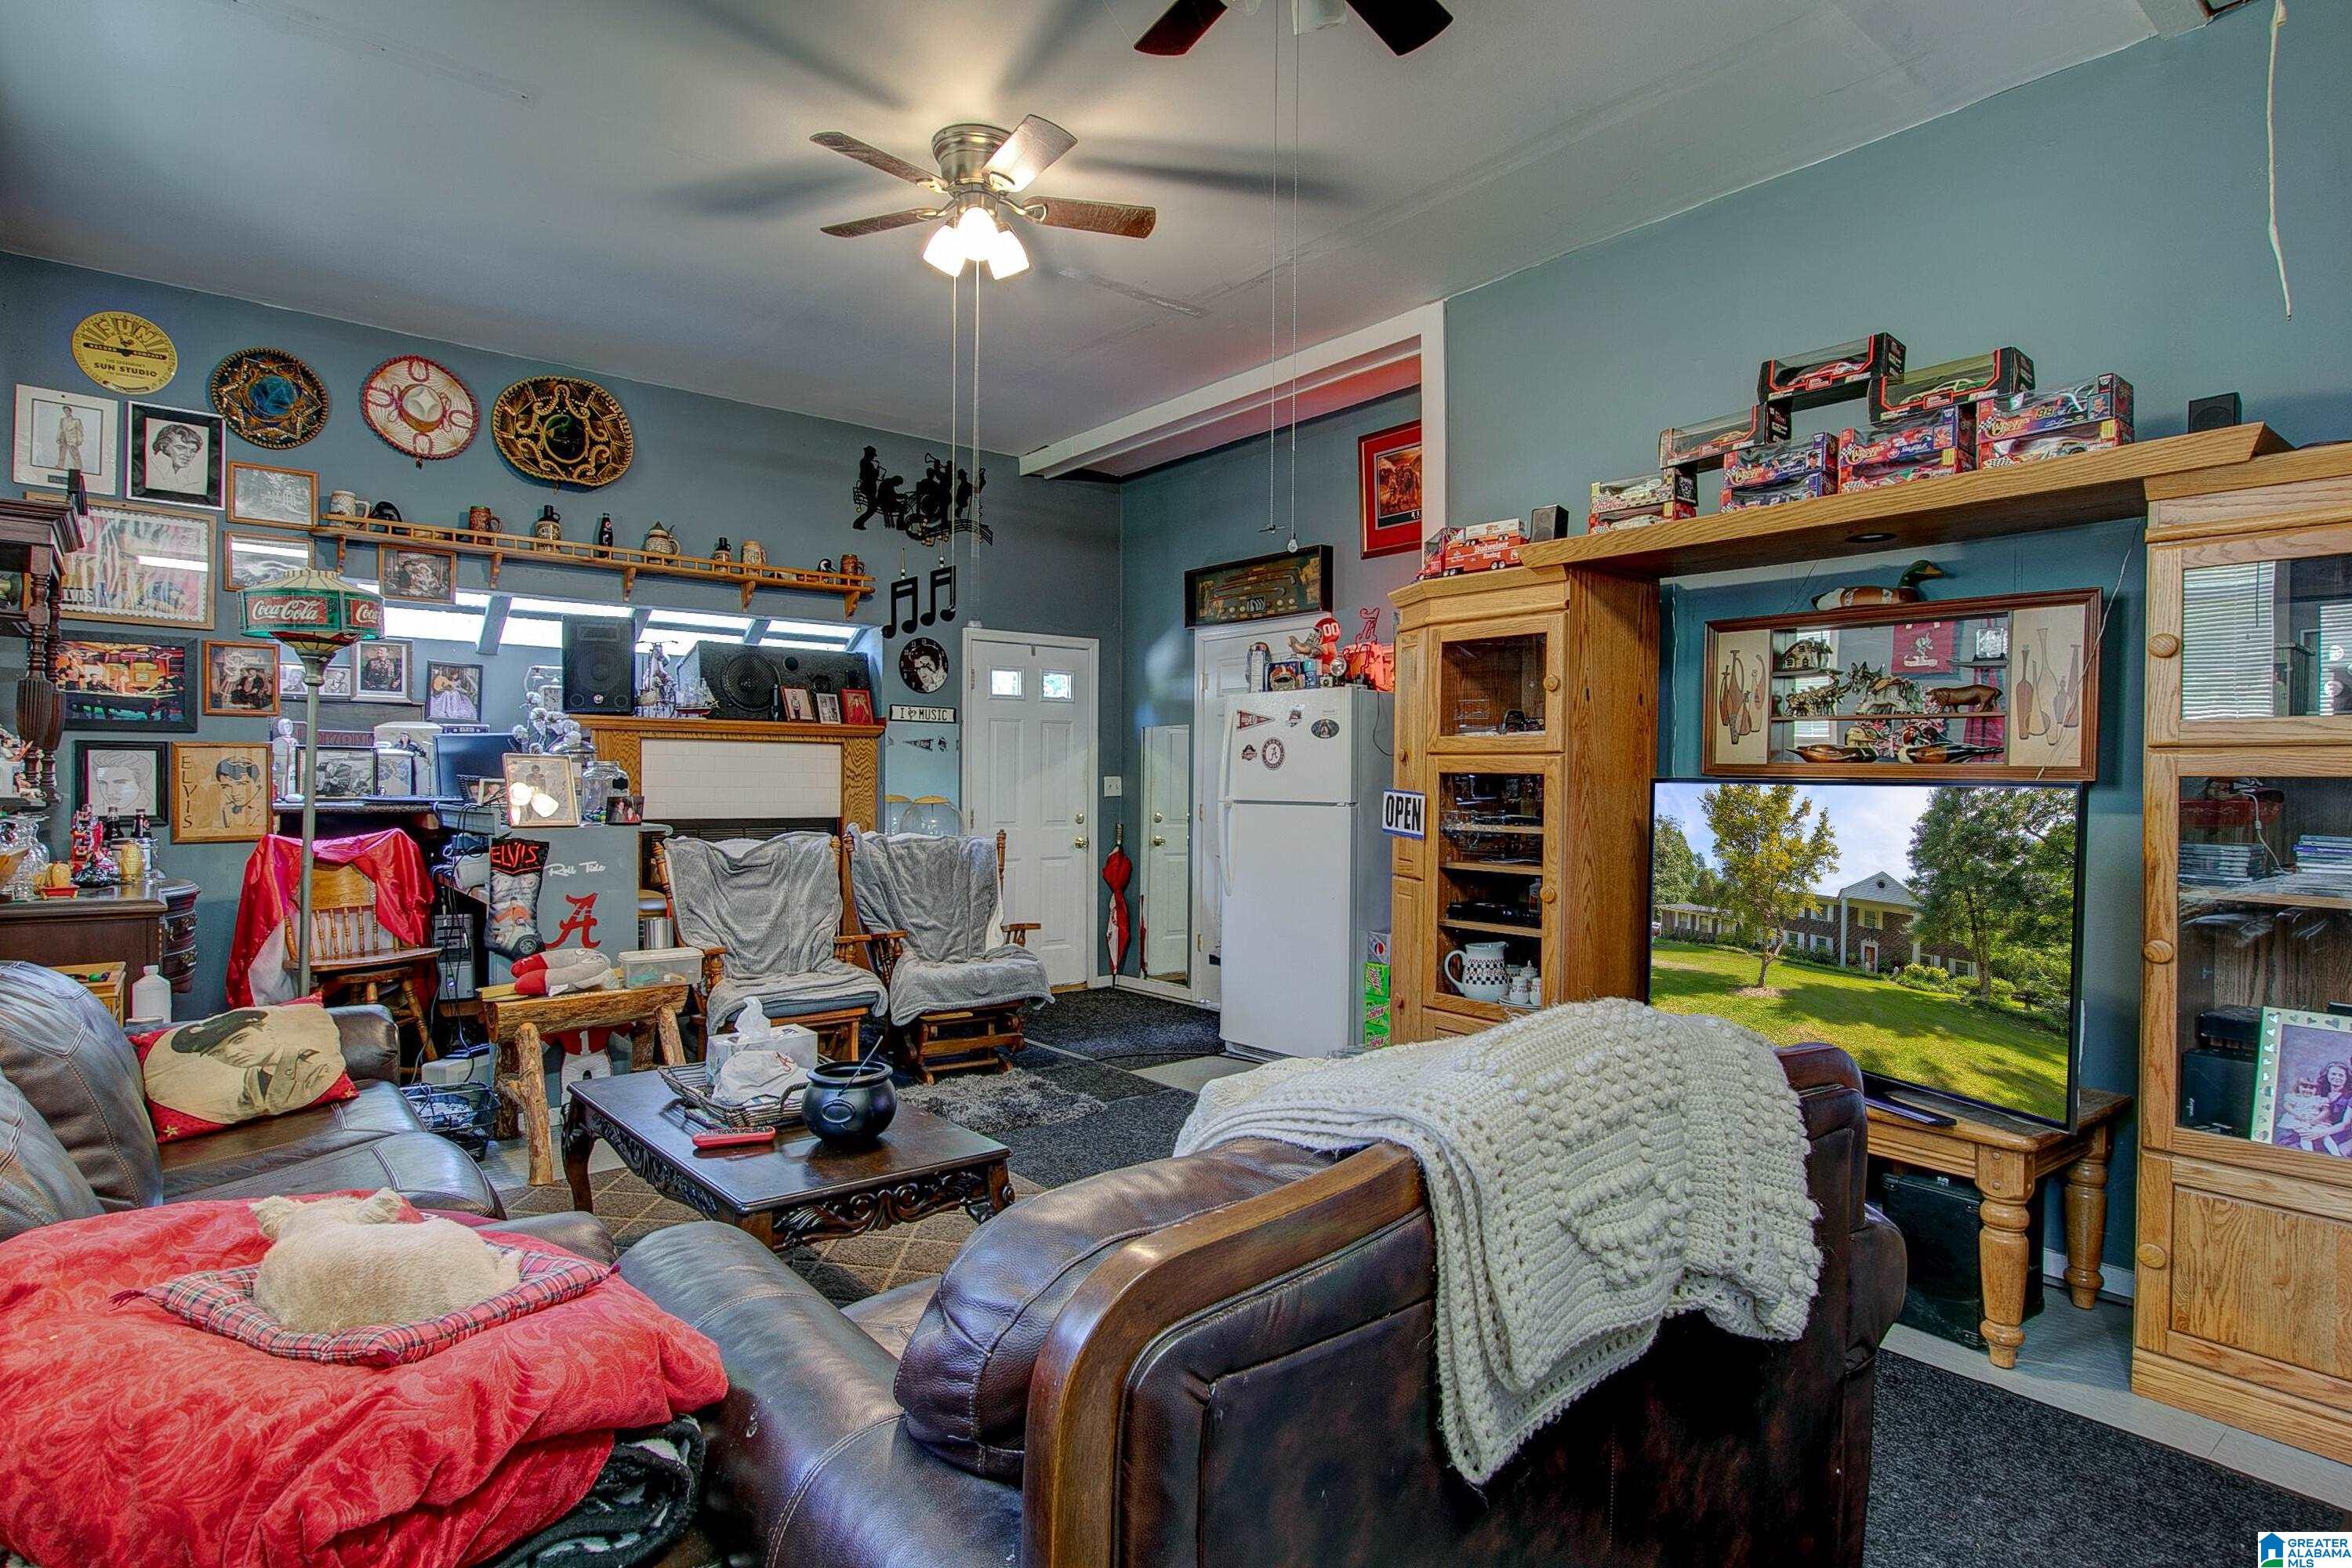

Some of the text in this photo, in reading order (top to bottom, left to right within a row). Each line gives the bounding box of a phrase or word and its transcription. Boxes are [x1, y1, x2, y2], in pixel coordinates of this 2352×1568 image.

[97, 318, 156, 342] SUN
[93, 362, 115, 371] SUN
[119, 365, 158, 377] STUDIO
[1475, 542, 1510, 554] Budweiser
[63, 588, 94, 603] LVIS
[1323, 623, 1339, 636] 00
[900, 707, 948, 720] I MUSIC
[182, 756, 198, 829] ELVIS
[1386, 794, 1421, 832] OPEN
[490, 843, 539, 868] ELVIS
[544, 861, 605, 877] Roll Tide
